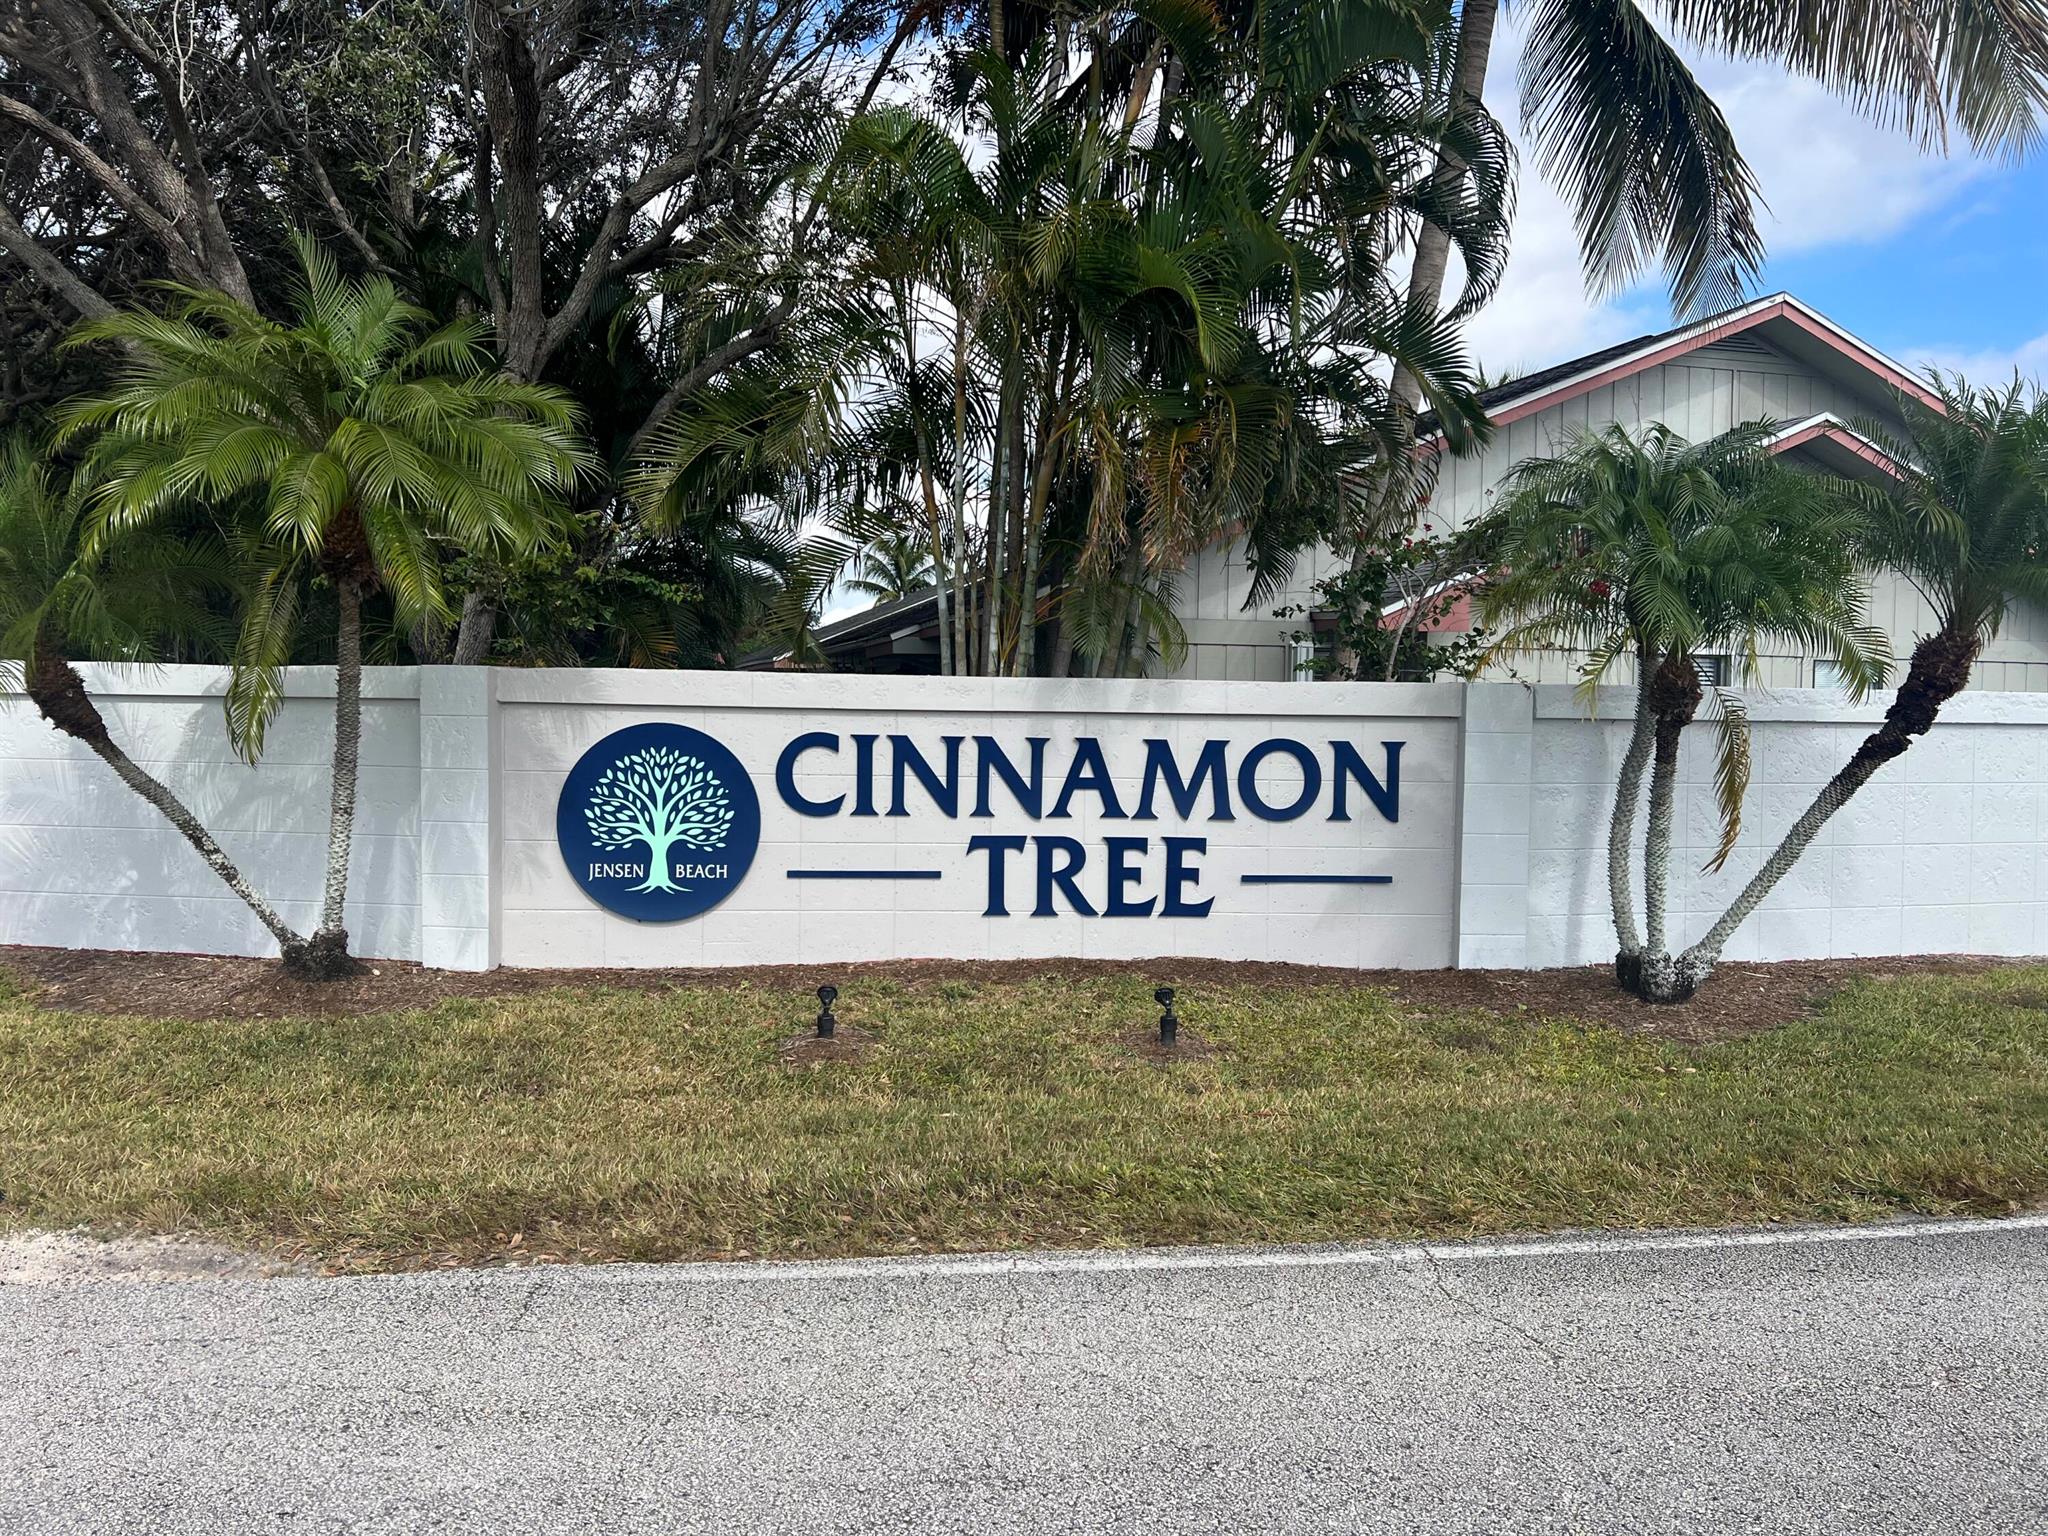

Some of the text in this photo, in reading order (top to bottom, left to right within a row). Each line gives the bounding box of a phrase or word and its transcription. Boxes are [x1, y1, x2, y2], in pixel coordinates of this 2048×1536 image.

[775, 731, 1407, 825] CINNAMON
[588, 863, 728, 882] JENSEN BEACH
[966, 835, 1216, 918] TREE
